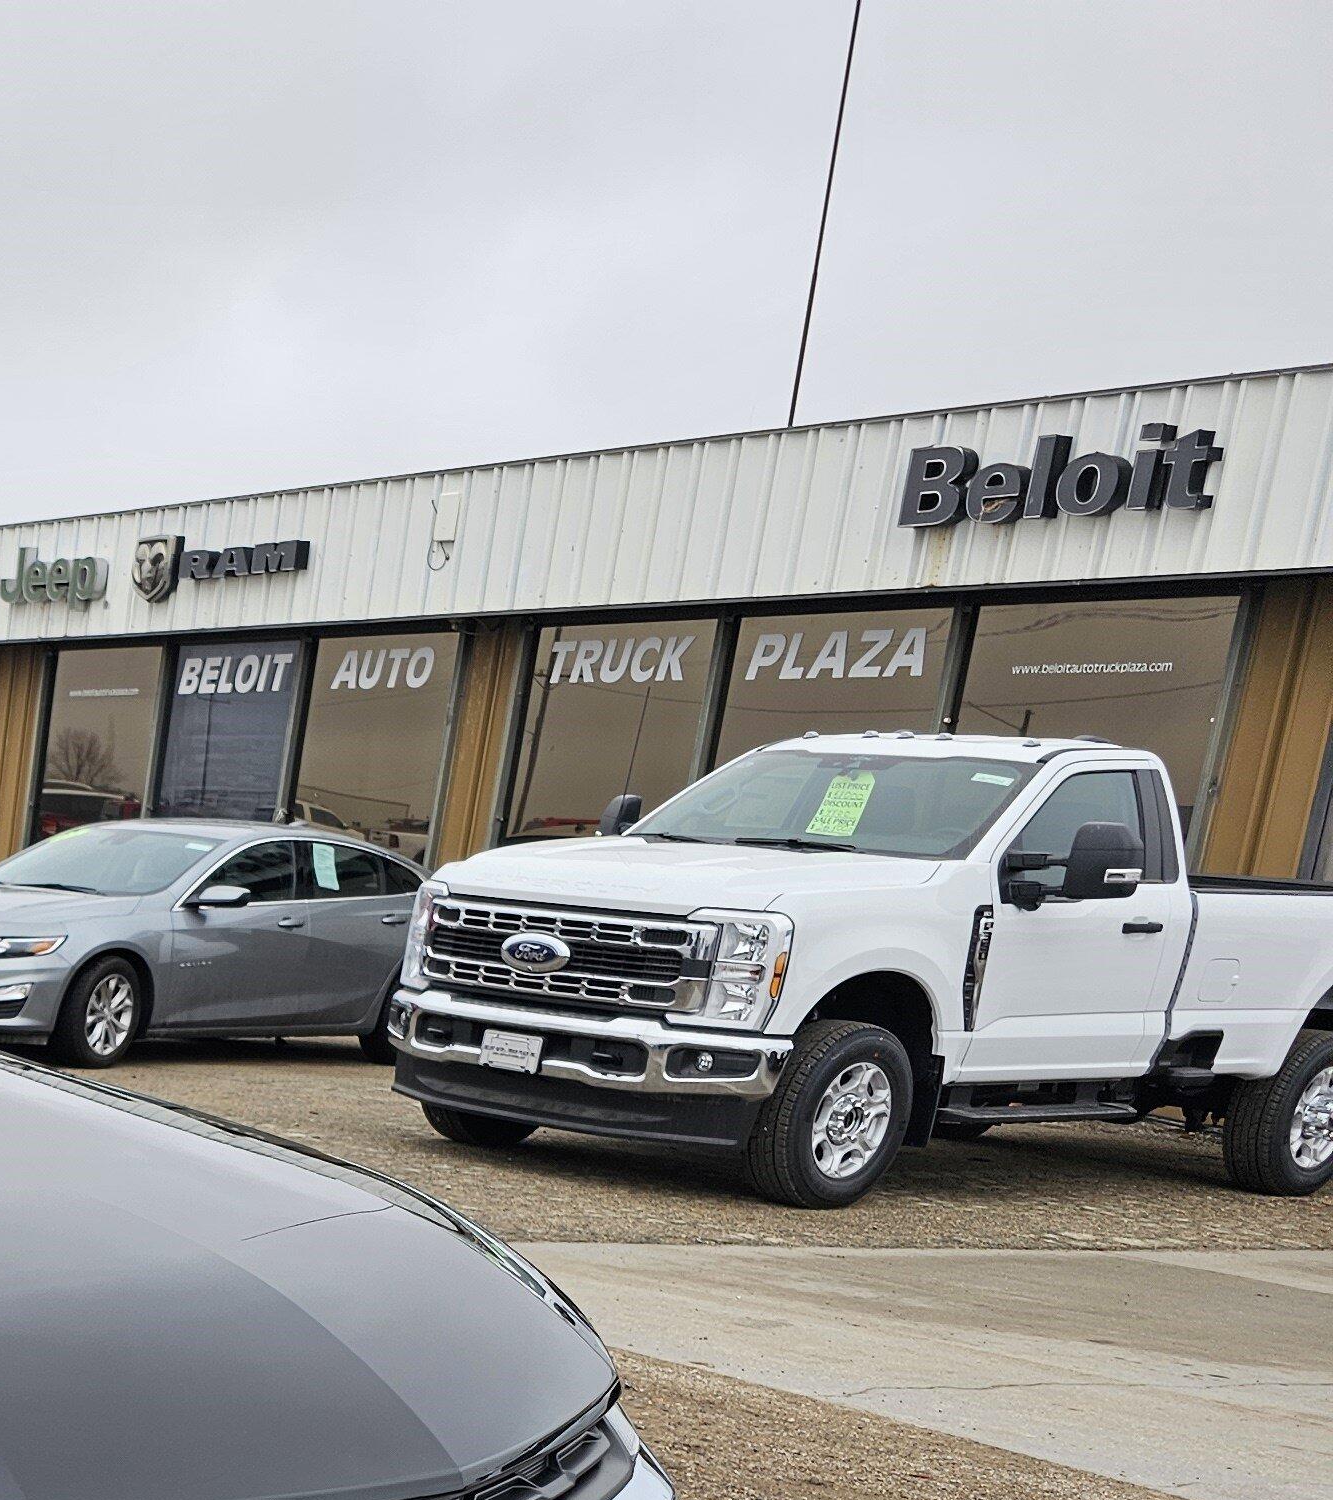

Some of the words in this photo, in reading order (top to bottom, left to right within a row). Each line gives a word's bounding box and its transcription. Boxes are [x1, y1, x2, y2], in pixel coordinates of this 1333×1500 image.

[897, 423, 1224, 528] Beloit
[0, 547, 109, 612] Jeep
[179, 540, 310, 580] RAM
[177, 653, 294, 695] BELOIT
[330, 646, 435, 690] AUTO
[549, 635, 697, 684] TRUCK
[744, 627, 927, 681] PLAZA
[1011, 661, 1173, 675] www.beloitautotruckplaza.com
